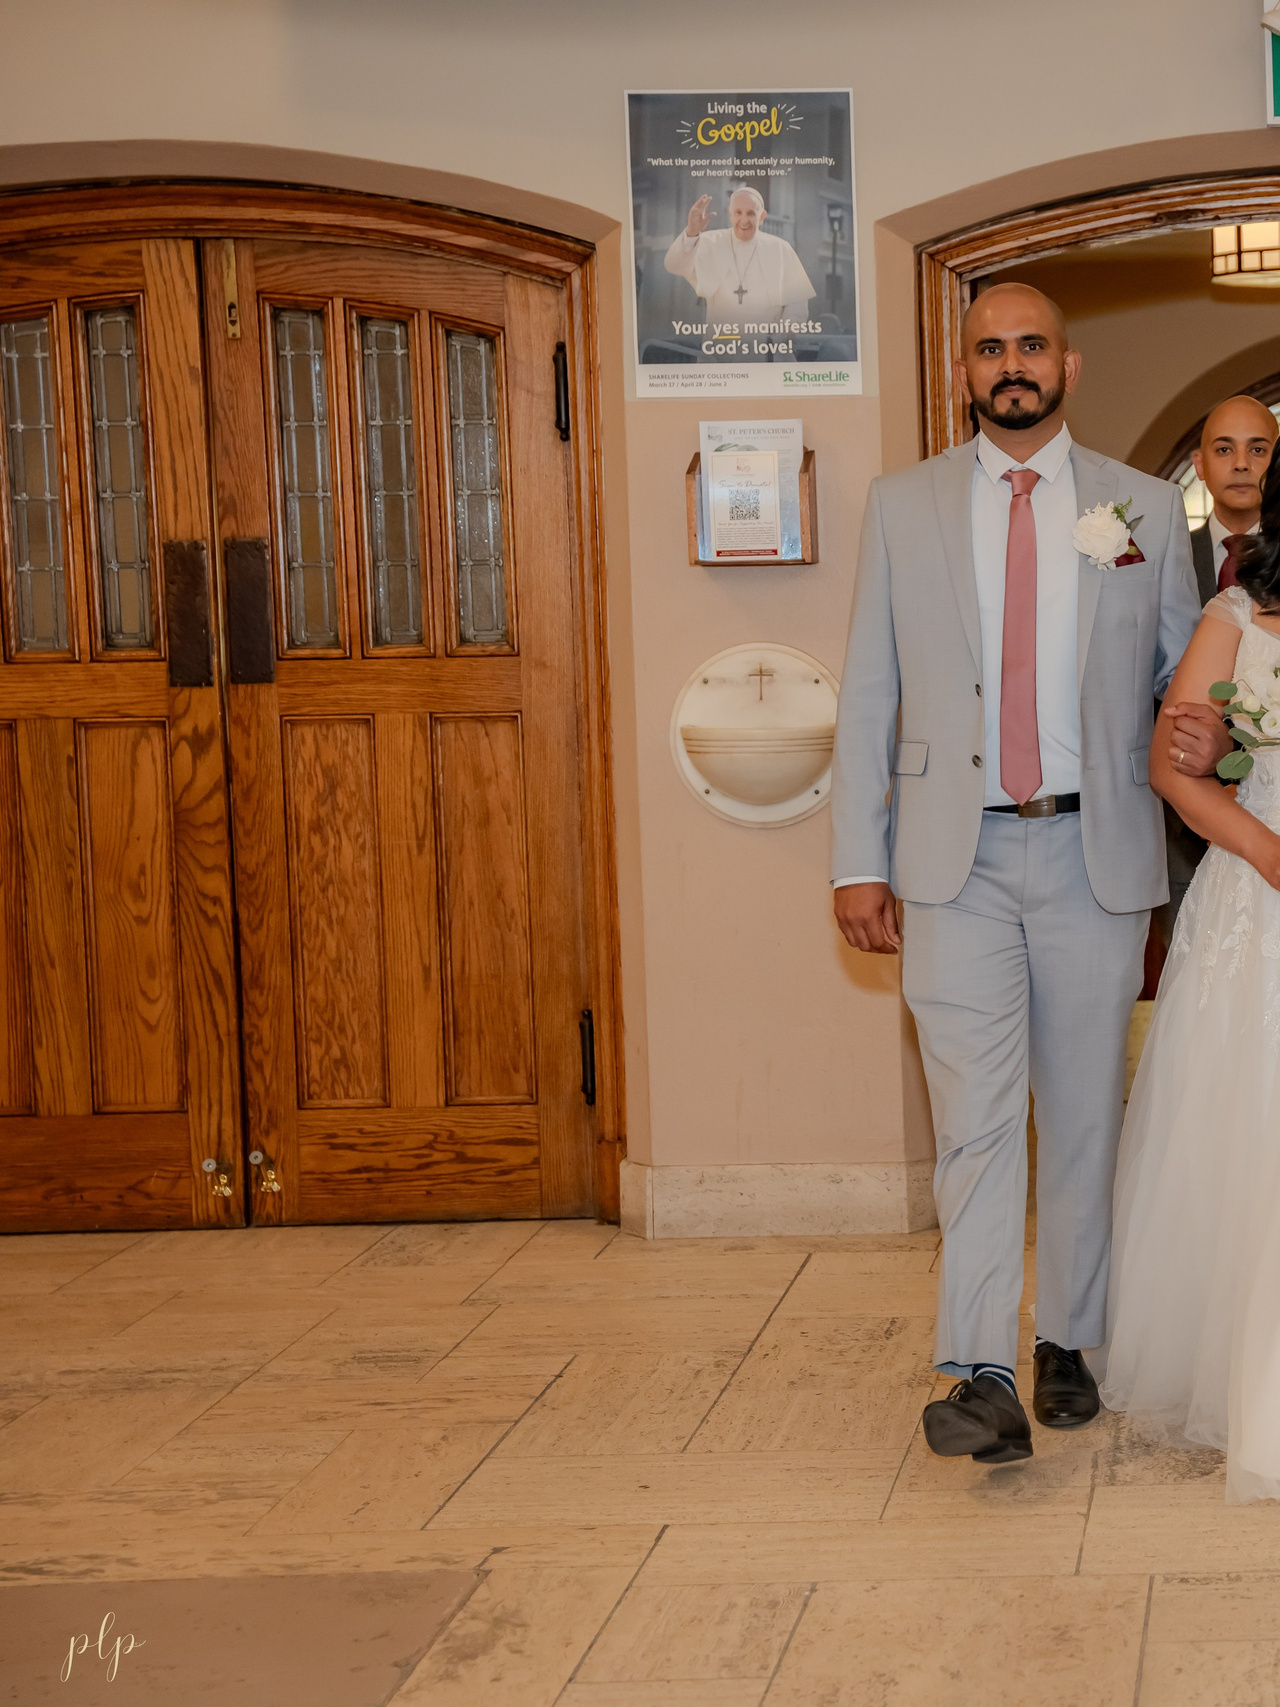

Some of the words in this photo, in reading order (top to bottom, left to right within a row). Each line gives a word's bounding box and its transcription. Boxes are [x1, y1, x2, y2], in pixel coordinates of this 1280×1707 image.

[707, 102, 744, 117] Living
[746, 102, 768, 114] the
[697, 107, 782, 152] Gospel
[675, 157, 688, 166] the
[690, 159, 710, 167] poor
[711, 157, 732, 165] need
[734, 156, 740, 165] is
[742, 157, 778, 167] certainly
[795, 156, 836, 166] humanity,
[734, 170, 755, 178] open
[672, 320, 708, 335] Your
[712, 322, 740, 338] yes
[744, 318, 822, 334] manifests
[702, 340, 750, 355] God's
[754, 340, 793, 354] love!
[795, 371, 849, 382] ShareLife
